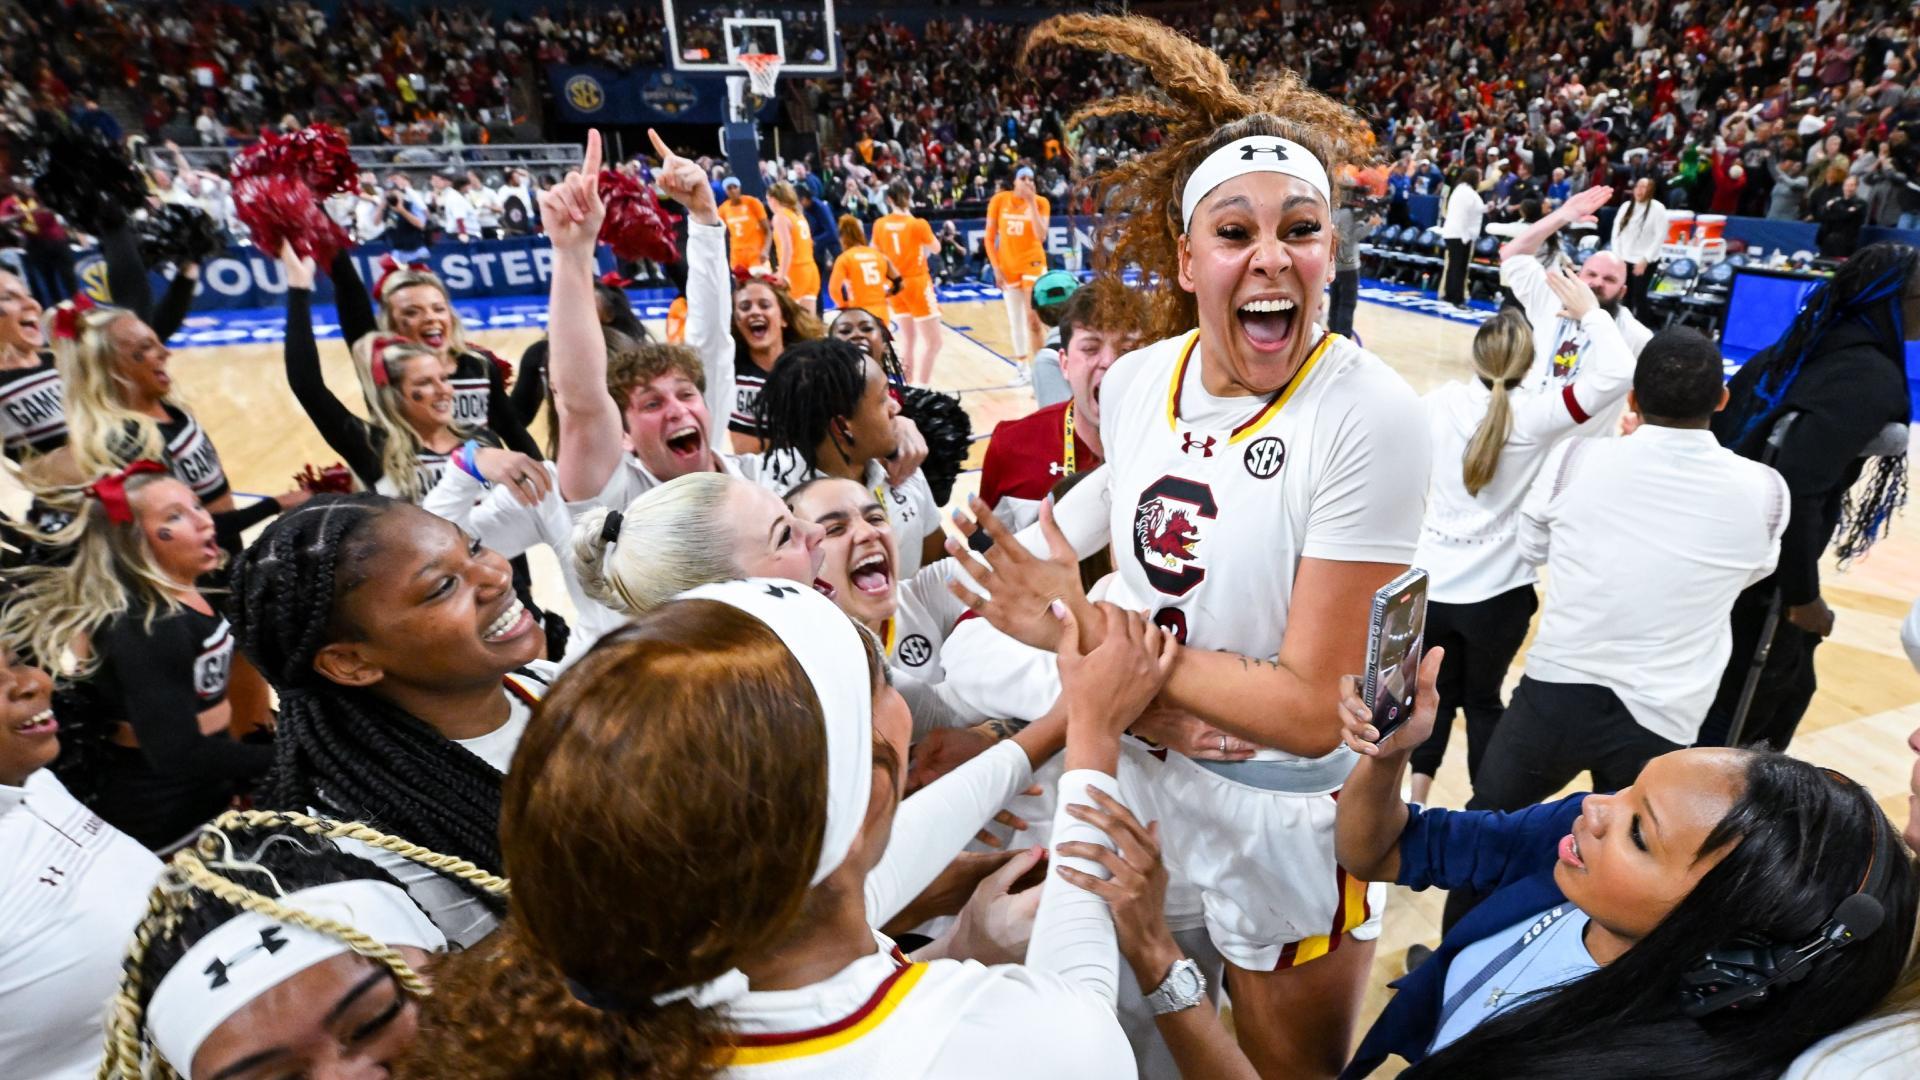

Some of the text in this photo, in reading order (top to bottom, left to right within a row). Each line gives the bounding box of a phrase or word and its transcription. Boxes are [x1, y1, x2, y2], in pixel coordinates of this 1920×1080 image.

[1006, 221, 1024, 235] 20
[892, 232, 901, 256] 1
[860, 262, 881, 286] 15
[1246, 438, 1284, 476] SEC
[900, 635, 932, 665] SEC
[1523, 907, 1563, 945] 2024
